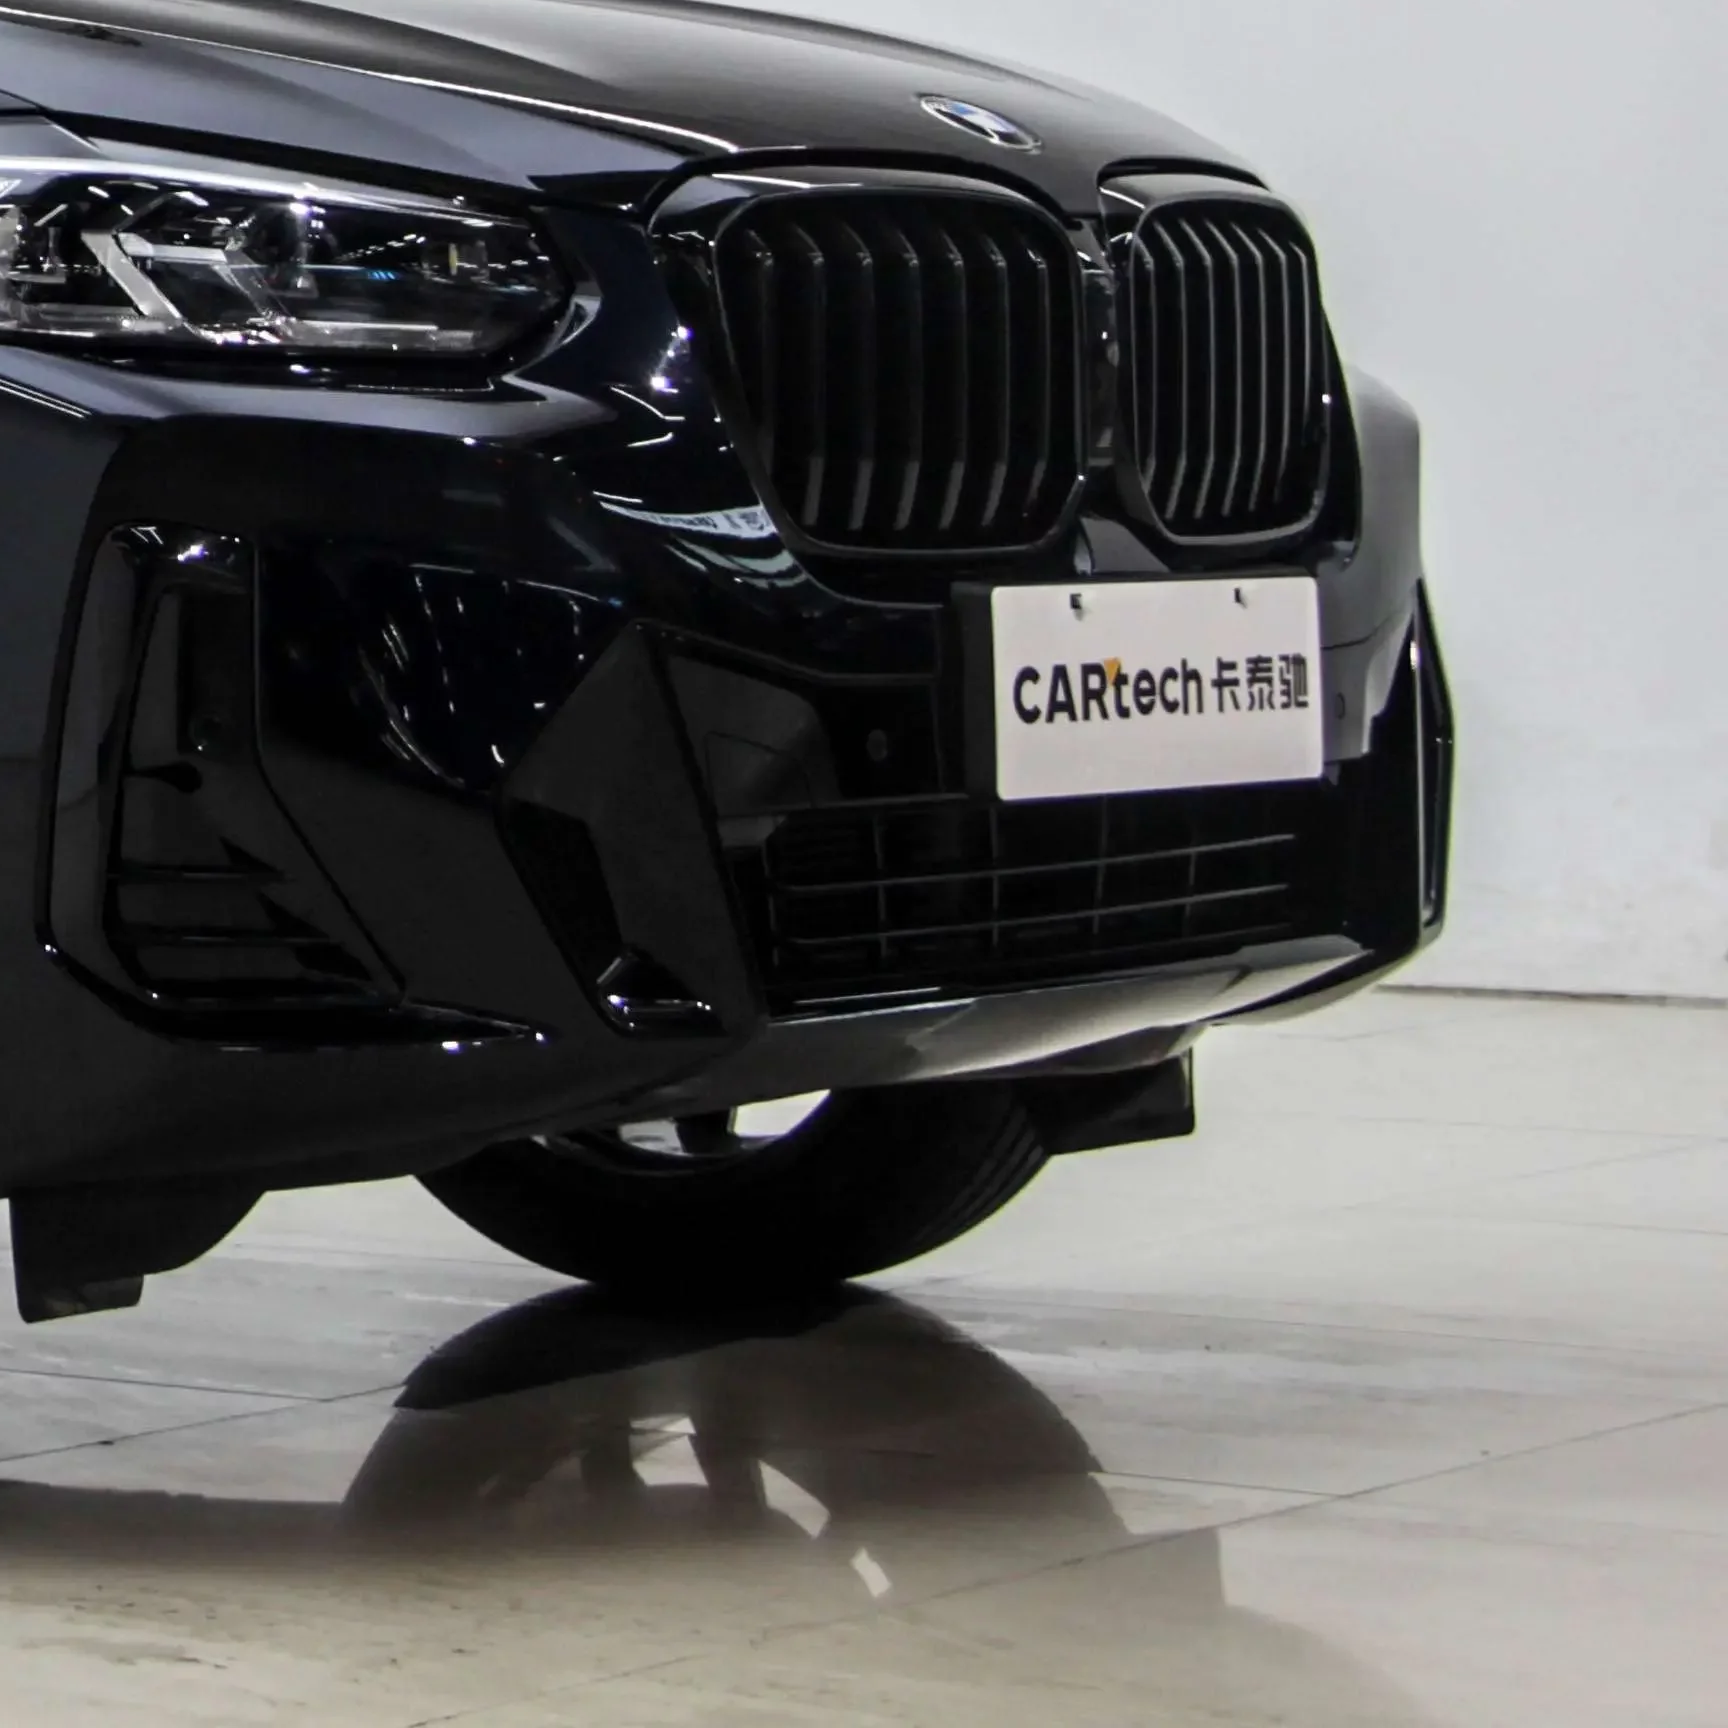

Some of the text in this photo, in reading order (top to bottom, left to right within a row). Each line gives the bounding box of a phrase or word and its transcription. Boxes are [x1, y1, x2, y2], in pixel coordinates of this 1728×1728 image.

[1013, 653, 1309, 725] CARtech 卡泰驰
